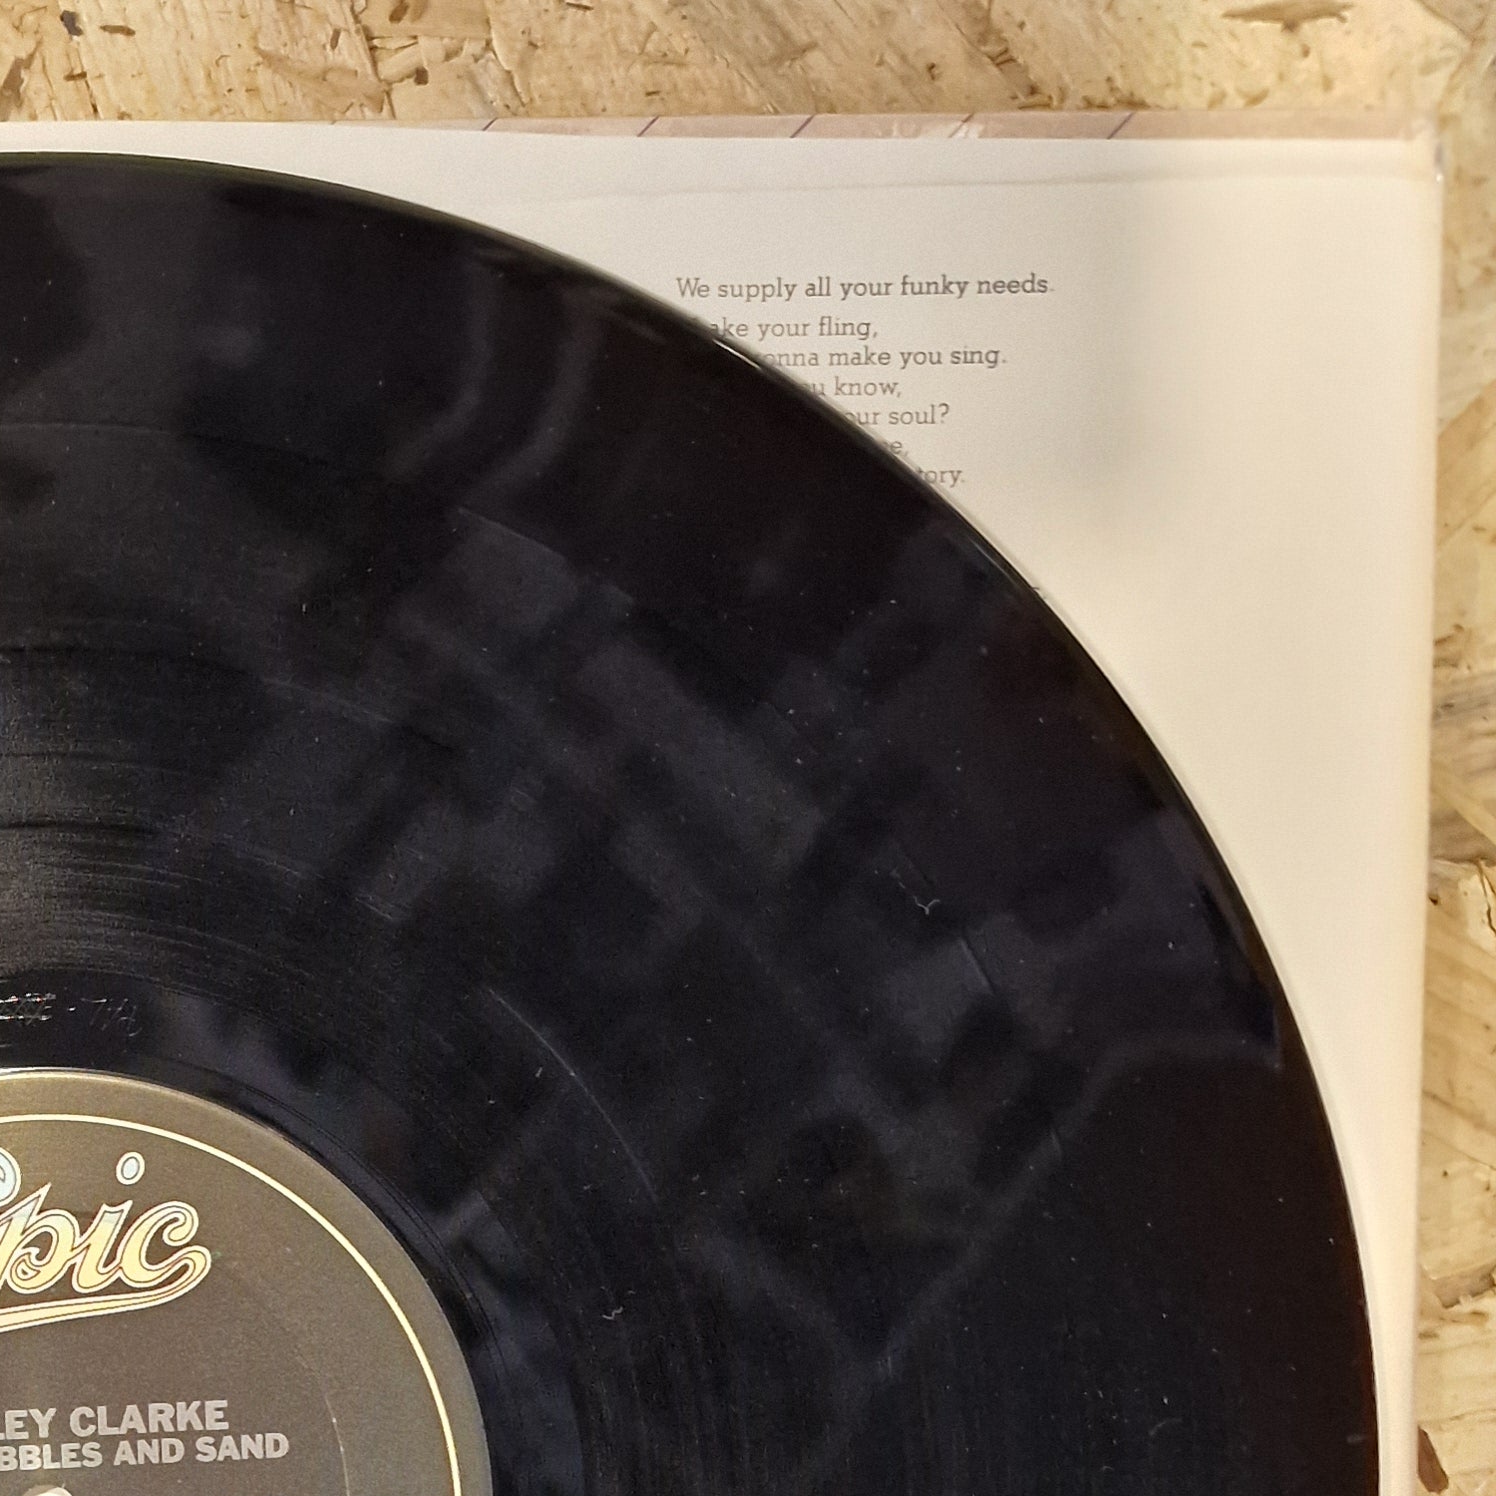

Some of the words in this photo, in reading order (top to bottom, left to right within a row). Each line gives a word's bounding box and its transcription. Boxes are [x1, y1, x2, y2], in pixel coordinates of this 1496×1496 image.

[677, 277, 710, 298] We
[717, 277, 797, 302] supply
[805, 276, 832, 297] all
[840, 281, 893, 300] your
[901, 274, 969, 299] funky
[977, 272, 1055, 295] needs.
[710, 317, 749, 337] ake
[758, 322, 811, 342] your
[819, 315, 878, 340] fling,
[762, 350, 820, 368] onna
[828, 345, 892, 367] make
[900, 350, 942, 369] you
[950, 346, 1008, 369] sing.
[834, 376, 902, 398] know,
[888, 403, 950, 426] soul?
[69, 1400, 230, 1438] CLARKE
[113, 1438, 185, 1466] AND
[195, 1432, 290, 1463] SAND
